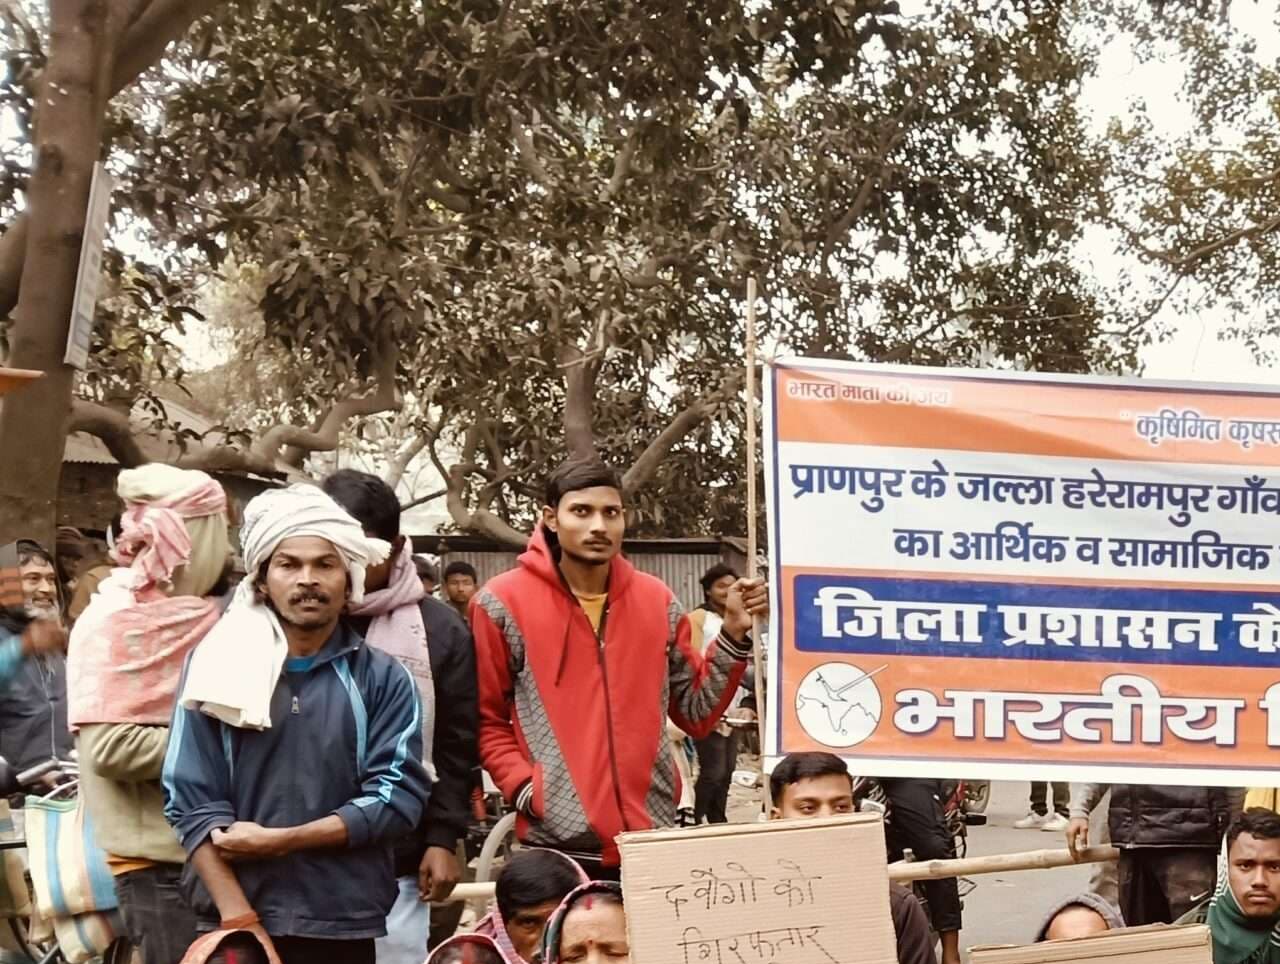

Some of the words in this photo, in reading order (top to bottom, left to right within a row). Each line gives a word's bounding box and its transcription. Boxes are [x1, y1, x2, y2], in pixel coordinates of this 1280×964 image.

[788, 381, 836, 399] भारत
[843, 384, 880, 401] माता
[788, 462, 905, 513] प्राणपुर
[910, 459, 949, 499] के
[954, 472, 1054, 506] जल्ला
[1061, 468, 1212, 528] हरेरामपुर
[892, 527, 943, 558] का
[948, 521, 1070, 564] आर्थिक
[1074, 535, 1103, 566] व
[1109, 530, 1272, 572] सामाजिक
[813, 586, 988, 644] जिला
[996, 601, 1224, 653] प्रशासन
[892, 673, 1247, 749] भारतीय
[773, 858, 823, 908] को
